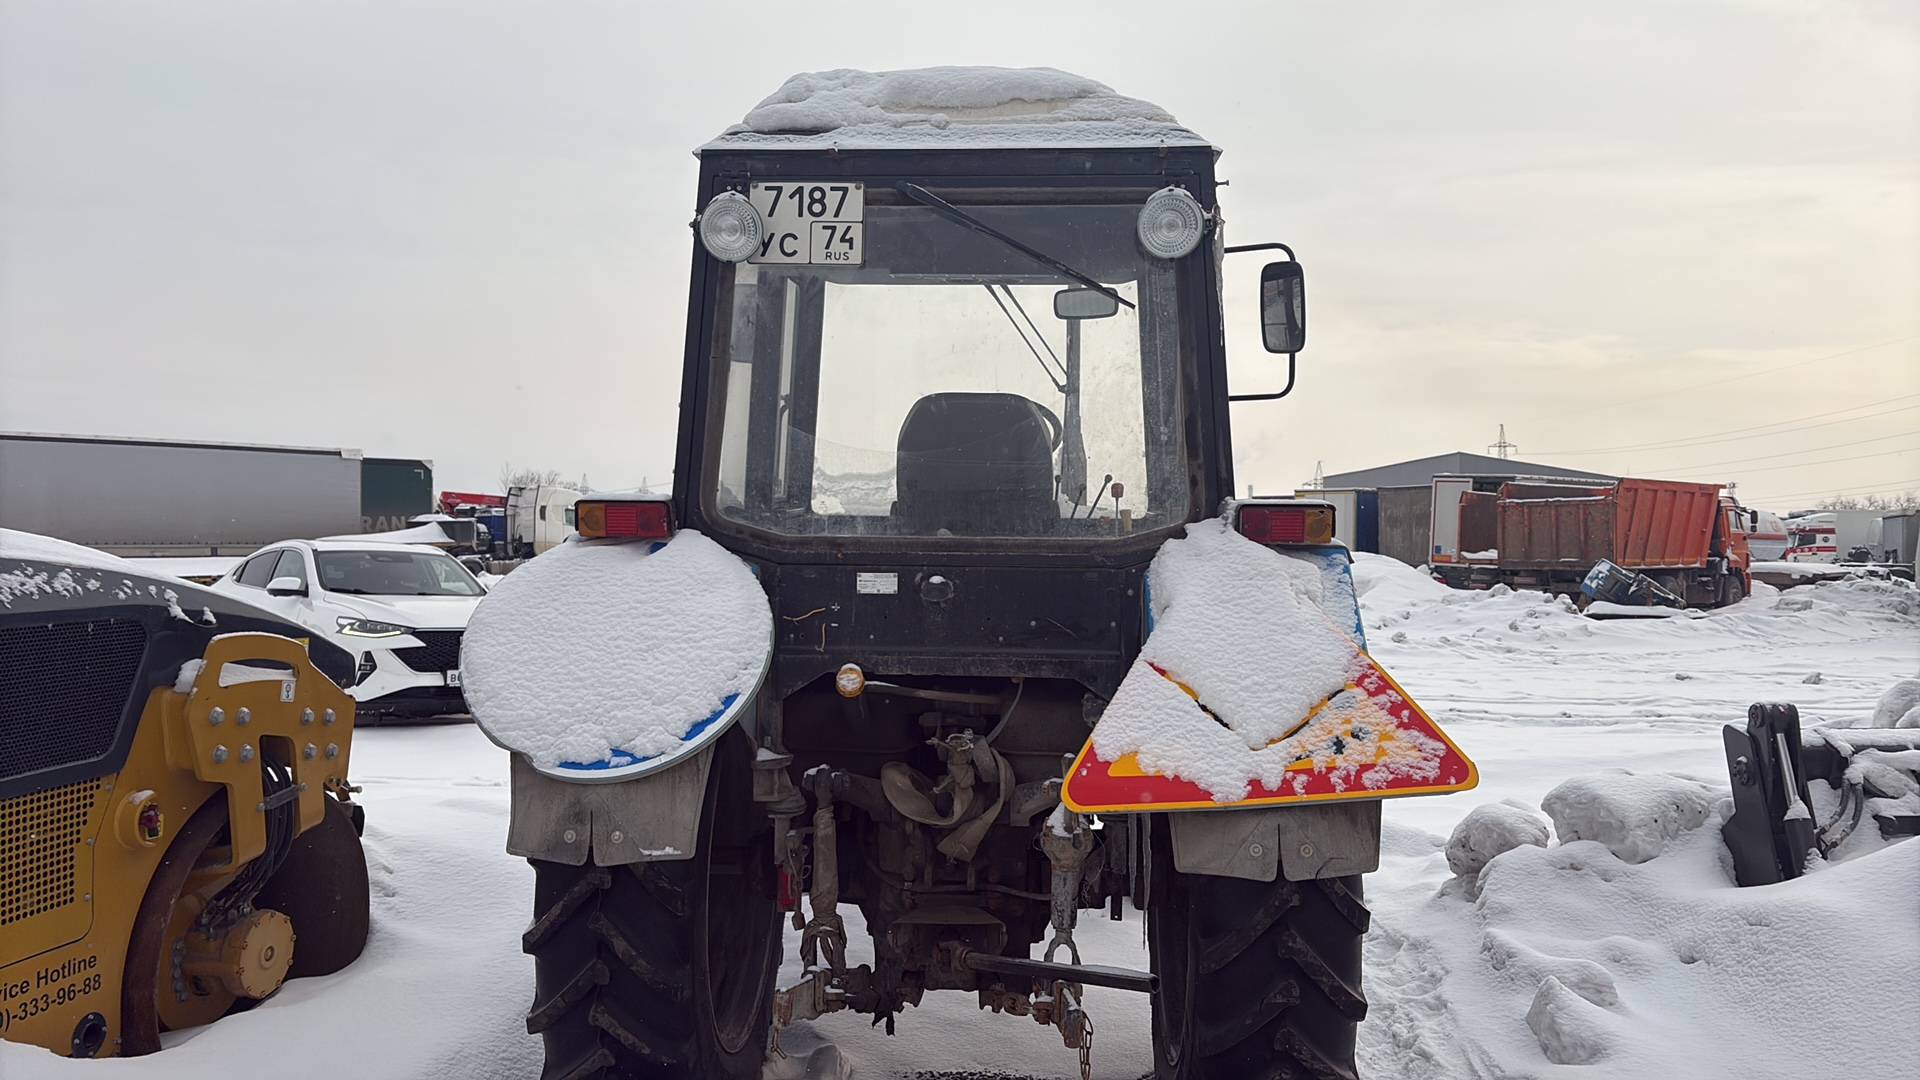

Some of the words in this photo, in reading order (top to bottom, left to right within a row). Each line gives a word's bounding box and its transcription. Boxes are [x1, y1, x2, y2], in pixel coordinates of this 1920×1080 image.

[764, 186, 849, 218] 7187
[822, 225, 854, 250] 74
[825, 252, 850, 261] RUS
[361, 515, 415, 532] RAN
[36, 955, 97, 989] Hotline
